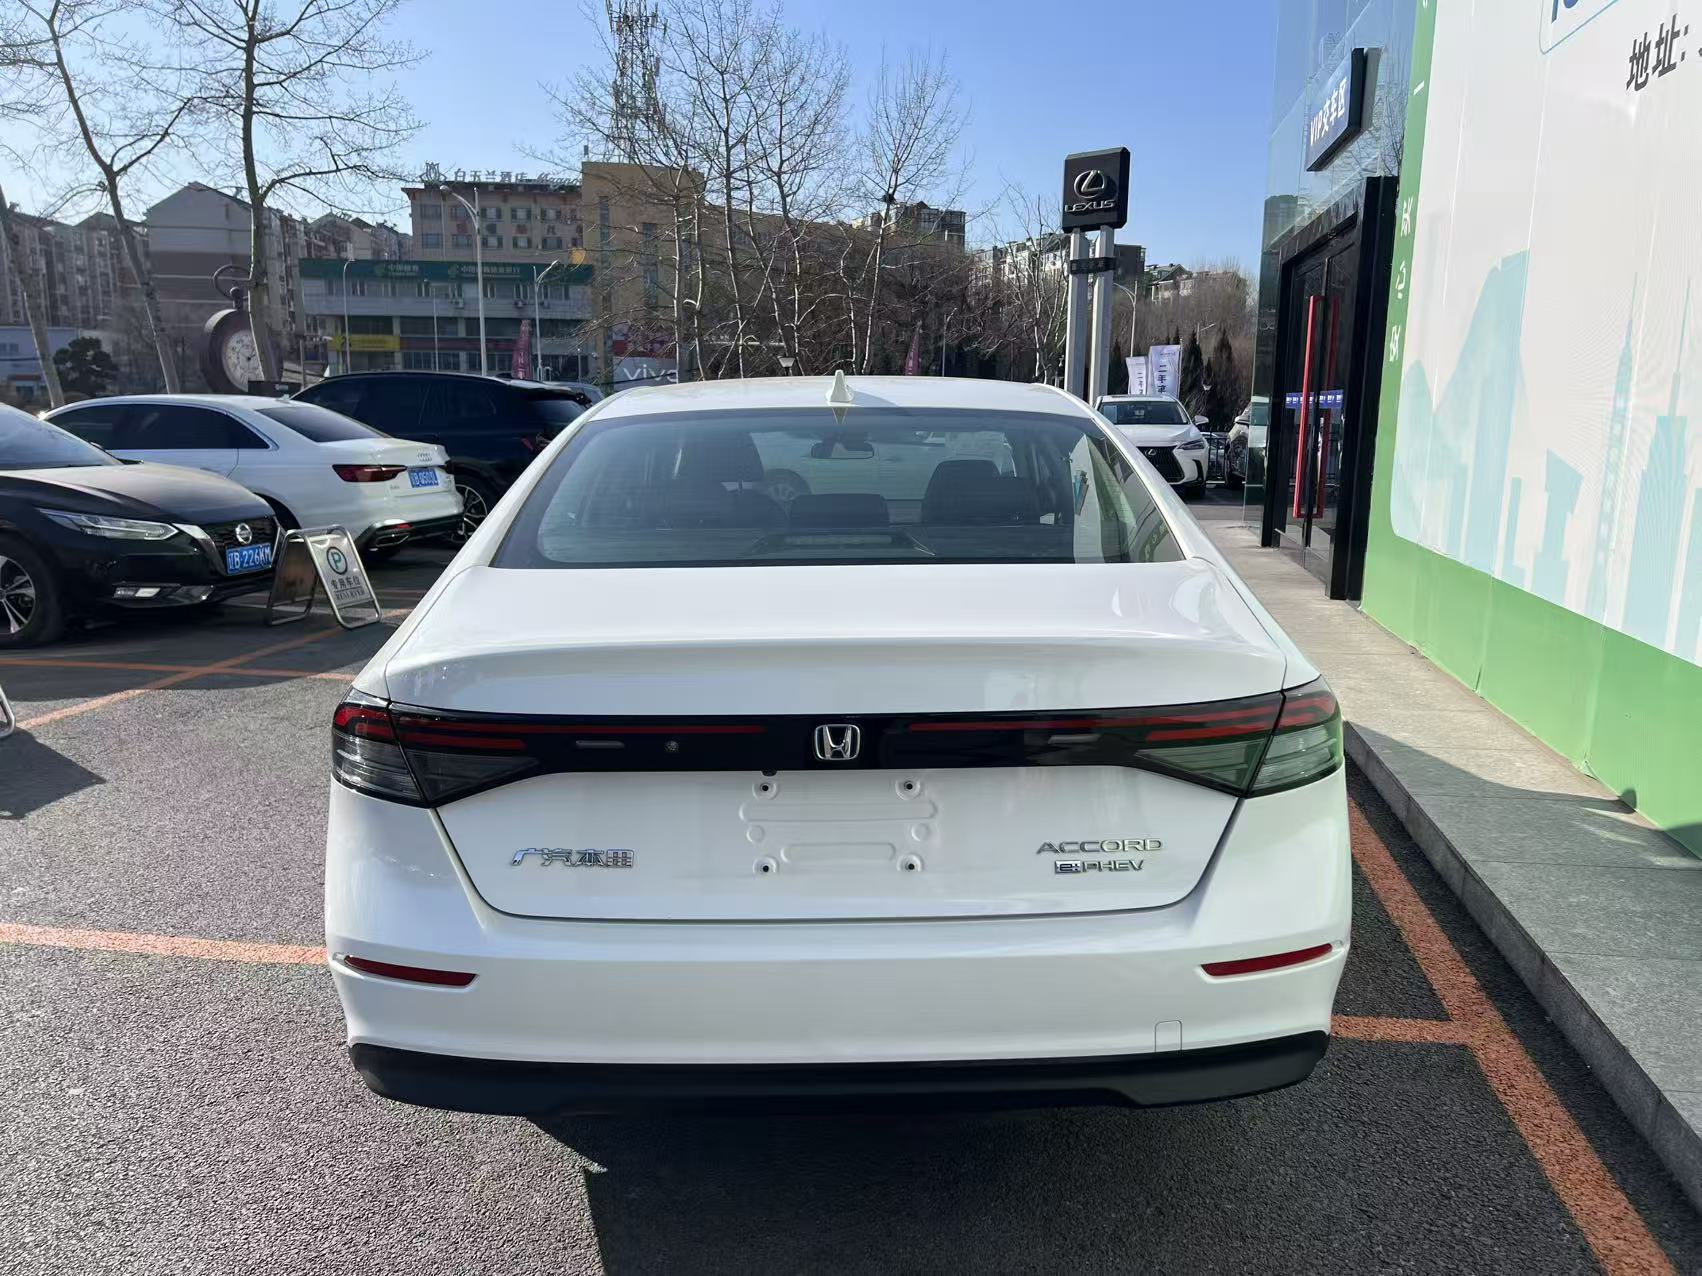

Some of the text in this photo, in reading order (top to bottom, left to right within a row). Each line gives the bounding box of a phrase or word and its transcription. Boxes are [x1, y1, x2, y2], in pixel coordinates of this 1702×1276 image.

[1064, 200, 1115, 212] LEXUS
[1036, 838, 1162, 855] ACCORD
[511, 848, 635, 868] 广汽本田
